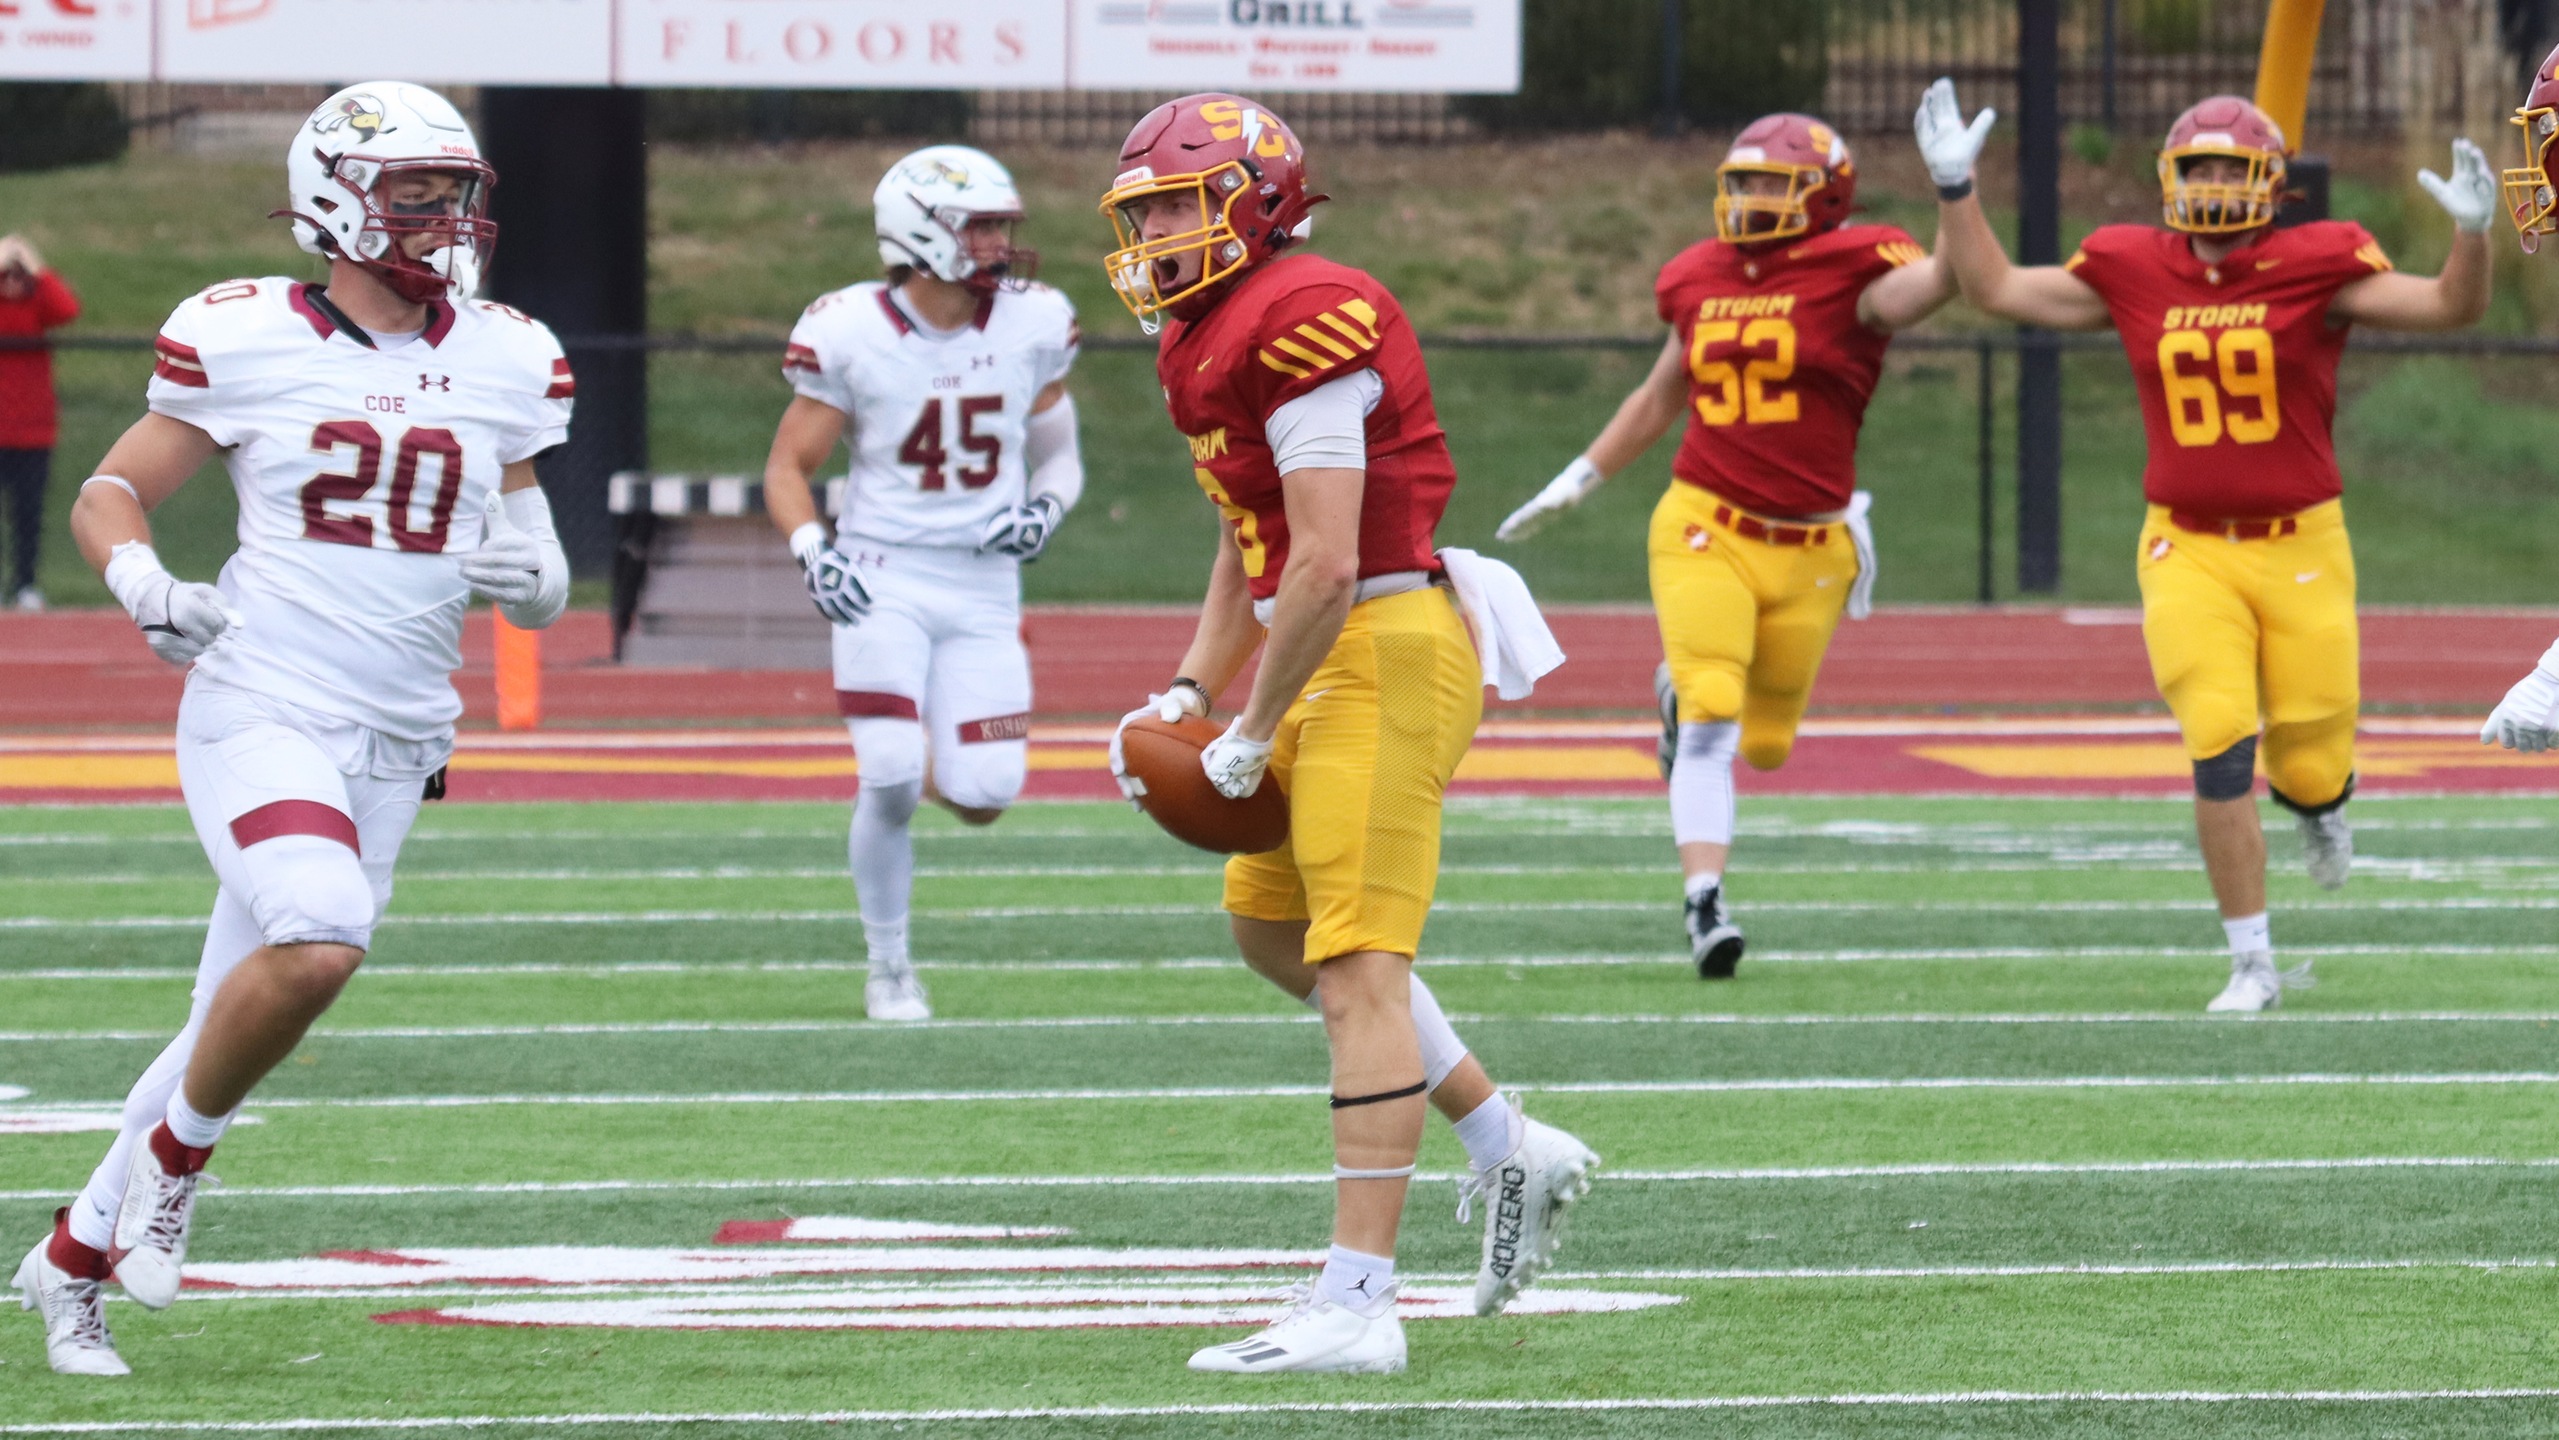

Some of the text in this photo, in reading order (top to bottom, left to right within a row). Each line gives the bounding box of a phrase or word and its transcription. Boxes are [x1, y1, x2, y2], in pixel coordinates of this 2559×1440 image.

[661, 18, 1028, 65] FLOORS
[1699, 294, 1797, 321] STORM
[2163, 302, 2268, 330] STORM
[931, 375, 963, 391] COE
[1690, 317, 1800, 427] 52
[2157, 328, 2282, 448] 69
[364, 394, 406, 414] COE
[898, 394, 1005, 492] 45
[1187, 426, 1229, 463] ORM
[299, 419, 463, 553] 20
